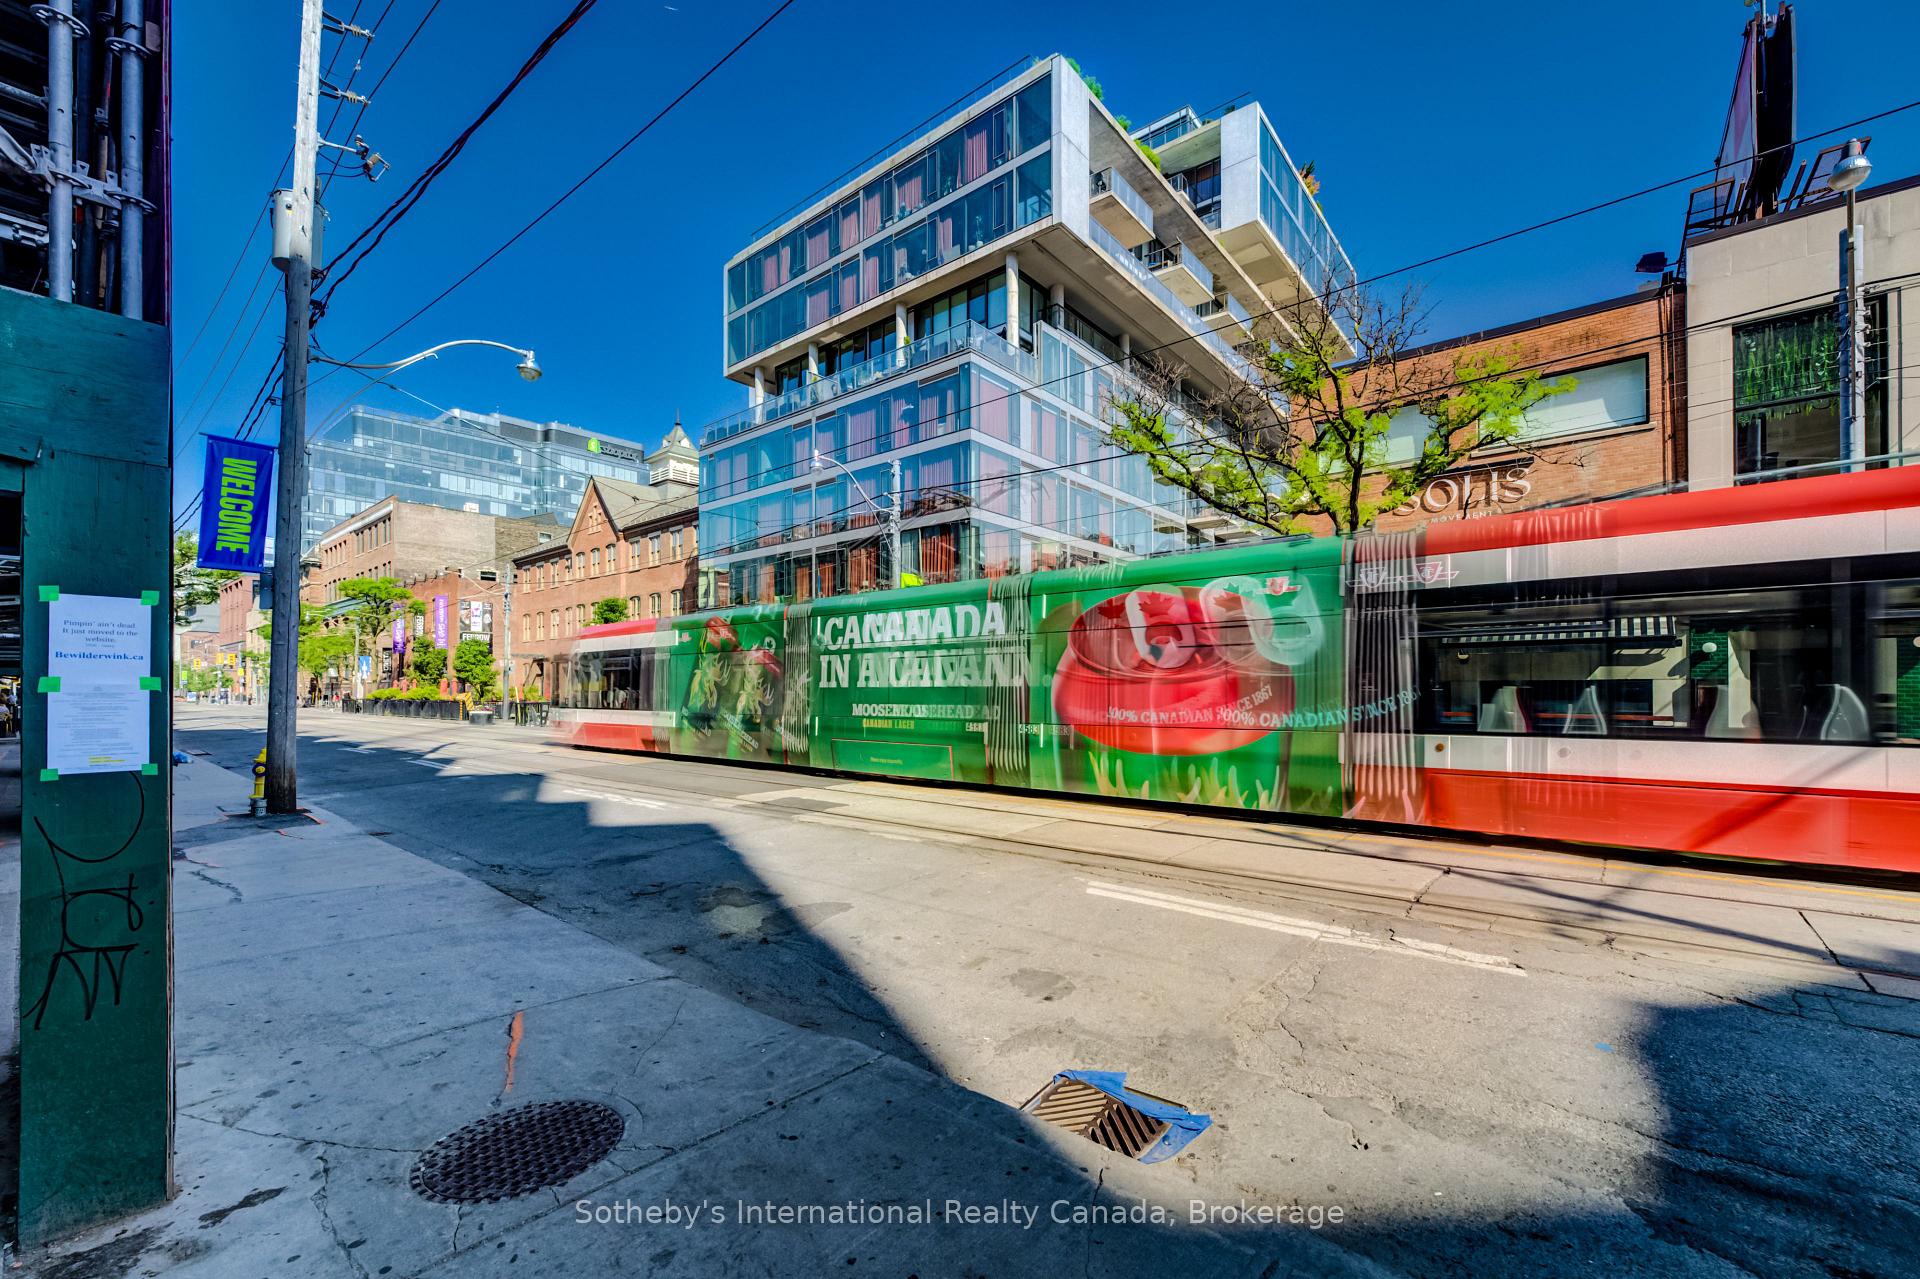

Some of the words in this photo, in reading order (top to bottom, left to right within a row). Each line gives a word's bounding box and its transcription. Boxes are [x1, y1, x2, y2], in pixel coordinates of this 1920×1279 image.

[215, 457, 257, 554] WELCOME
[55, 651, 144, 661] Bewilderwink.ca
[819, 655, 850, 688] IN
